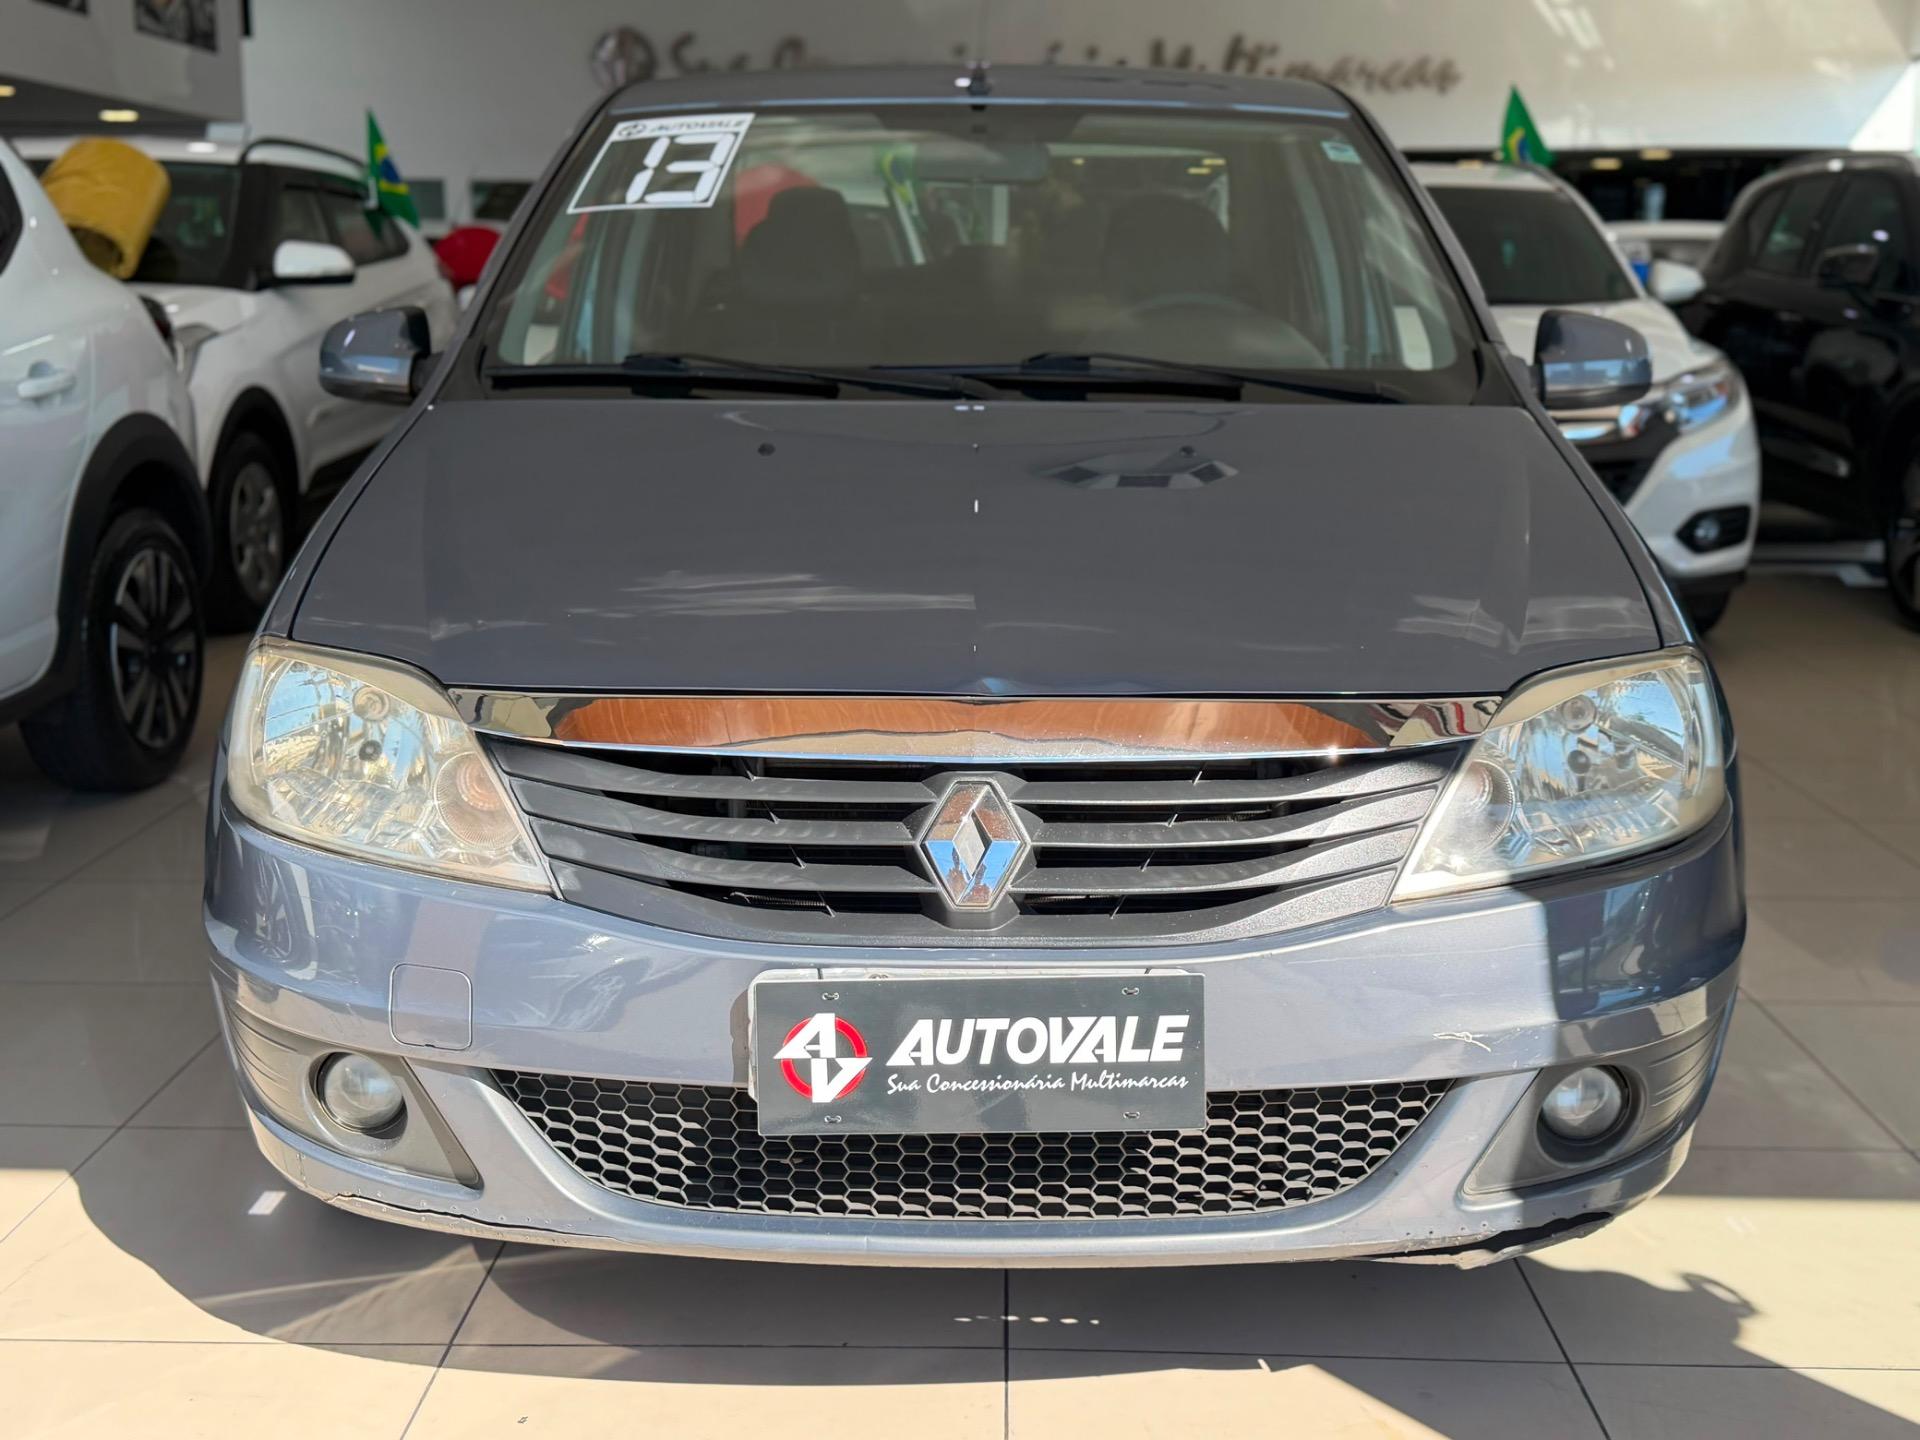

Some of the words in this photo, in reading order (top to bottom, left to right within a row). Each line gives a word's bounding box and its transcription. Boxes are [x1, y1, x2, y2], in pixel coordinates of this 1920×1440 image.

[625, 133, 736, 205] 13
[885, 1015, 1190, 1067] AUTOVALE
[887, 1073, 921, 1095] Sua
[926, 1073, 1066, 1093] Concessionária
[1070, 1069, 1189, 1092] Multimarcas
